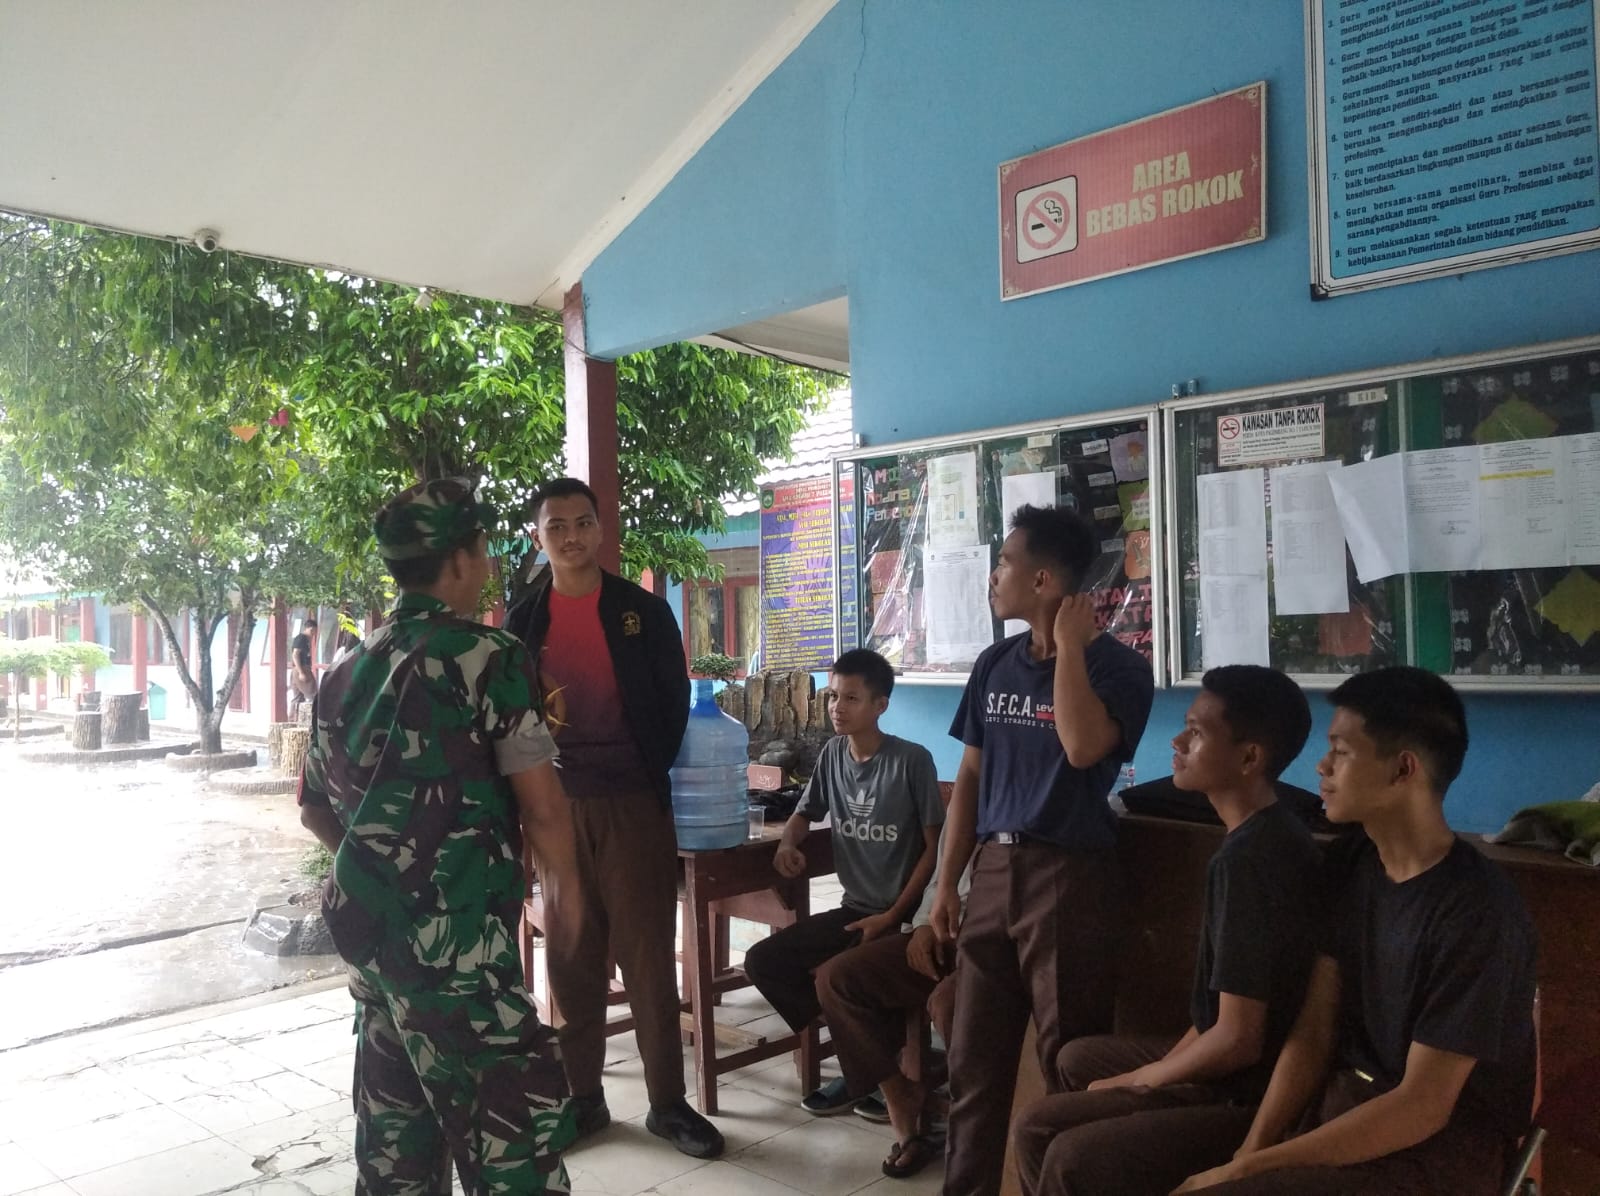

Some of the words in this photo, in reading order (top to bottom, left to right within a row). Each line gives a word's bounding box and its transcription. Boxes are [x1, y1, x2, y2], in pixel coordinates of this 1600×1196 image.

[1340, 12, 1361, 24] Guru
[1436, 32, 1466, 46] dengan
[1341, 51, 1361, 62] Guru
[1366, 33, 1420, 55] menciptakan
[1342, 90, 1361, 100] Guru
[1454, 54, 1486, 69] dengan
[1396, 82, 1431, 98] maupun
[1438, 64, 1493, 87] masyarakat
[1500, 56, 1524, 71] yang
[1343, 129, 1362, 139] Guru
[1468, 96, 1485, 107] dan
[1492, 89, 1513, 100] atau
[1467, 110, 1484, 119] dan
[1132, 151, 1192, 193] AREA
[1344, 167, 1363, 178] Guru
[1366, 154, 1420, 173] menciptakan
[1422, 150, 1438, 160] dan
[1442, 136, 1493, 154] memelihara
[1497, 129, 1522, 141] antar
[1345, 178, 1363, 190] baik
[1466, 146, 1501, 161] maupun
[1514, 137, 1543, 149] dalam
[1085, 193, 1157, 238] BEBAS
[1161, 168, 1245, 218] ROKOK
[1345, 206, 1367, 217] Guru
[1373, 189, 1442, 210] bersama-sama
[1518, 161, 1566, 178] membina
[1573, 155, 1593, 166] dan
[1347, 209, 1404, 228] meningkatkan
[1406, 204, 1428, 216] mutu
[1431, 191, 1476, 210] organisasi
[1479, 189, 1500, 200] Guru
[1503, 175, 1554, 194] Profesional
[1557, 167, 1594, 184] sebagai
[1347, 246, 1367, 256] Guru
[1370, 232, 1430, 251] melaksanakan
[1434, 225, 1462, 238] segala
[1466, 216, 1511, 231] ketentuan
[1514, 210, 1538, 224] yang
[1541, 199, 1596, 216] merupakan
[1347, 228, 1375, 240] sarana
[1408, 239, 1456, 257] Pemerintah
[1457, 234, 1484, 245] dalam
[1484, 226, 1516, 241] bidang
[1242, 411, 1273, 432] KAWASAN
[1274, 409, 1296, 428] TANPA
[1296, 406, 1321, 425] ROKOK
[1003, 717, 1036, 727] STRAUSS
